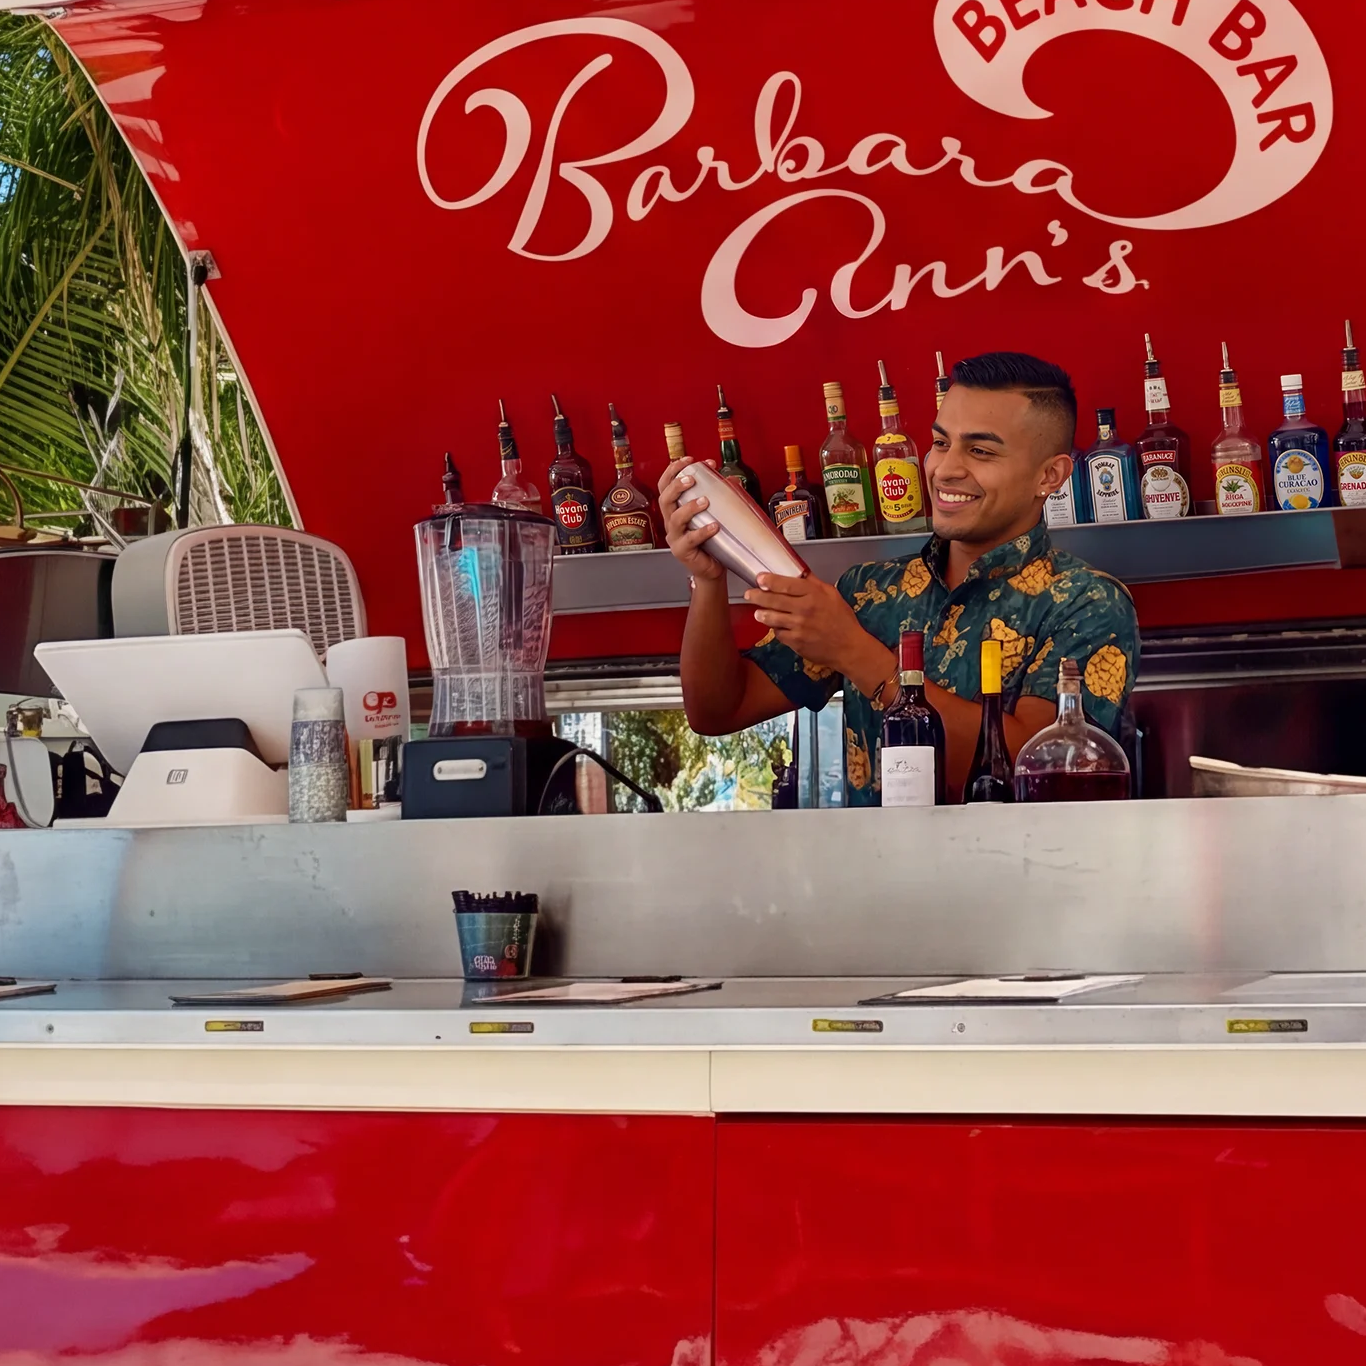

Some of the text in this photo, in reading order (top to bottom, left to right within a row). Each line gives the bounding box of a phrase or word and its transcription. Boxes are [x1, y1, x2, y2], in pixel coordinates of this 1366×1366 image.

[416, 16, 1125, 262] Barbara
[700, 187, 1151, 349] Ann's
[884, 486, 905, 497] Club
[555, 503, 589, 515] Havana
[561, 514, 583, 524] Club
